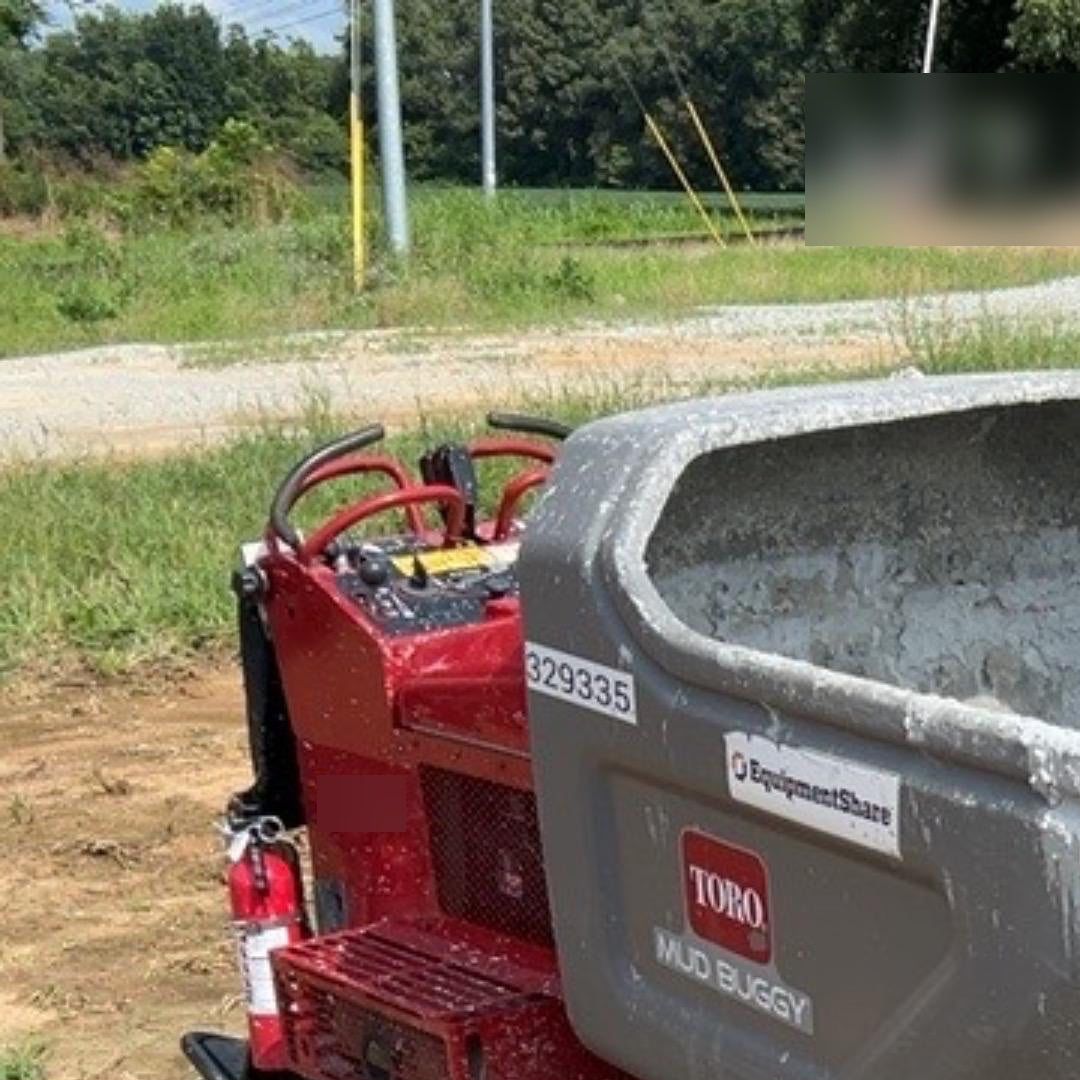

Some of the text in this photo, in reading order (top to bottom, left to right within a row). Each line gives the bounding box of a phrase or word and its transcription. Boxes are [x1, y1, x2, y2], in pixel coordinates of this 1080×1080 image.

[526, 651, 631, 713] 329335
[749, 758, 892, 826] EquipmentShare
[689, 864, 764, 928] TORO
[655, 931, 809, 1025] MUD BUGGY
